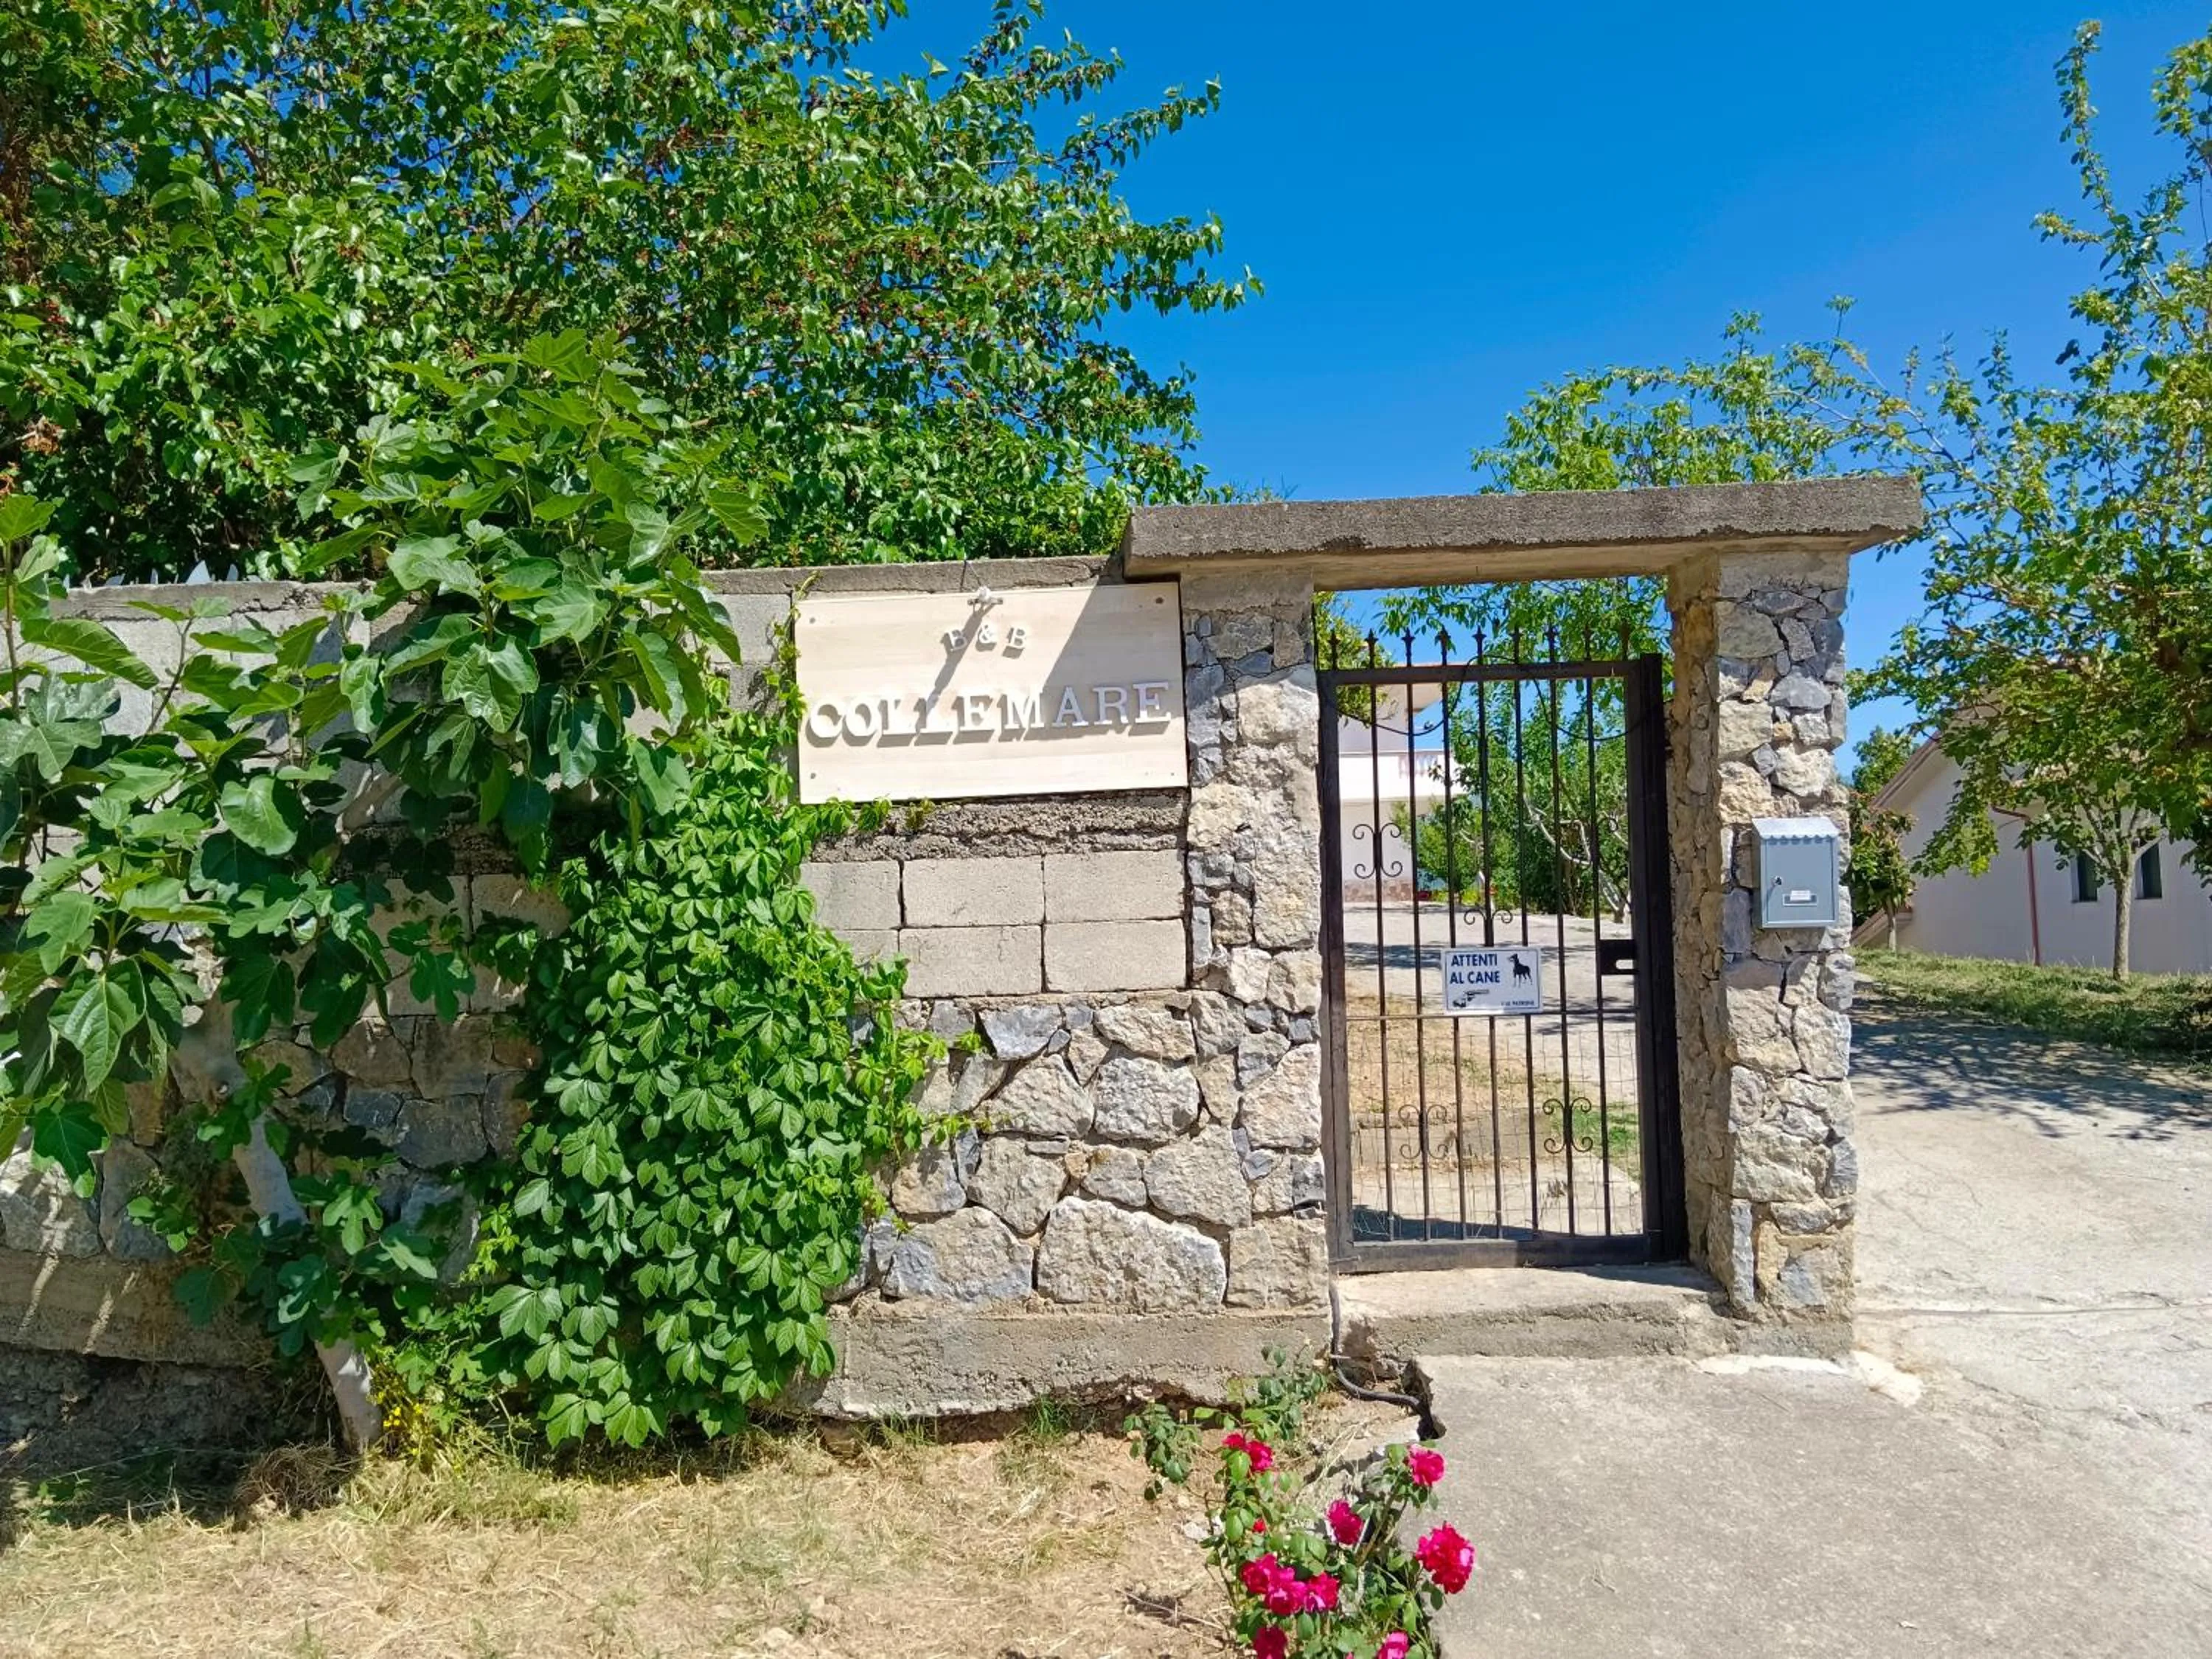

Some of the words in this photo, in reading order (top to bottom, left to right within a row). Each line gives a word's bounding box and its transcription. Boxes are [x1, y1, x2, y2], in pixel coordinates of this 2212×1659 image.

[947, 626, 968, 651] B
[977, 621, 998, 644] &
[1008, 626, 1028, 650] B
[810, 681, 1171, 739] COLLEMARE
[1451, 953, 1498, 967] ATTENTI
[1450, 971, 1464, 984] AL
[1467, 970, 1500, 984] CANE
